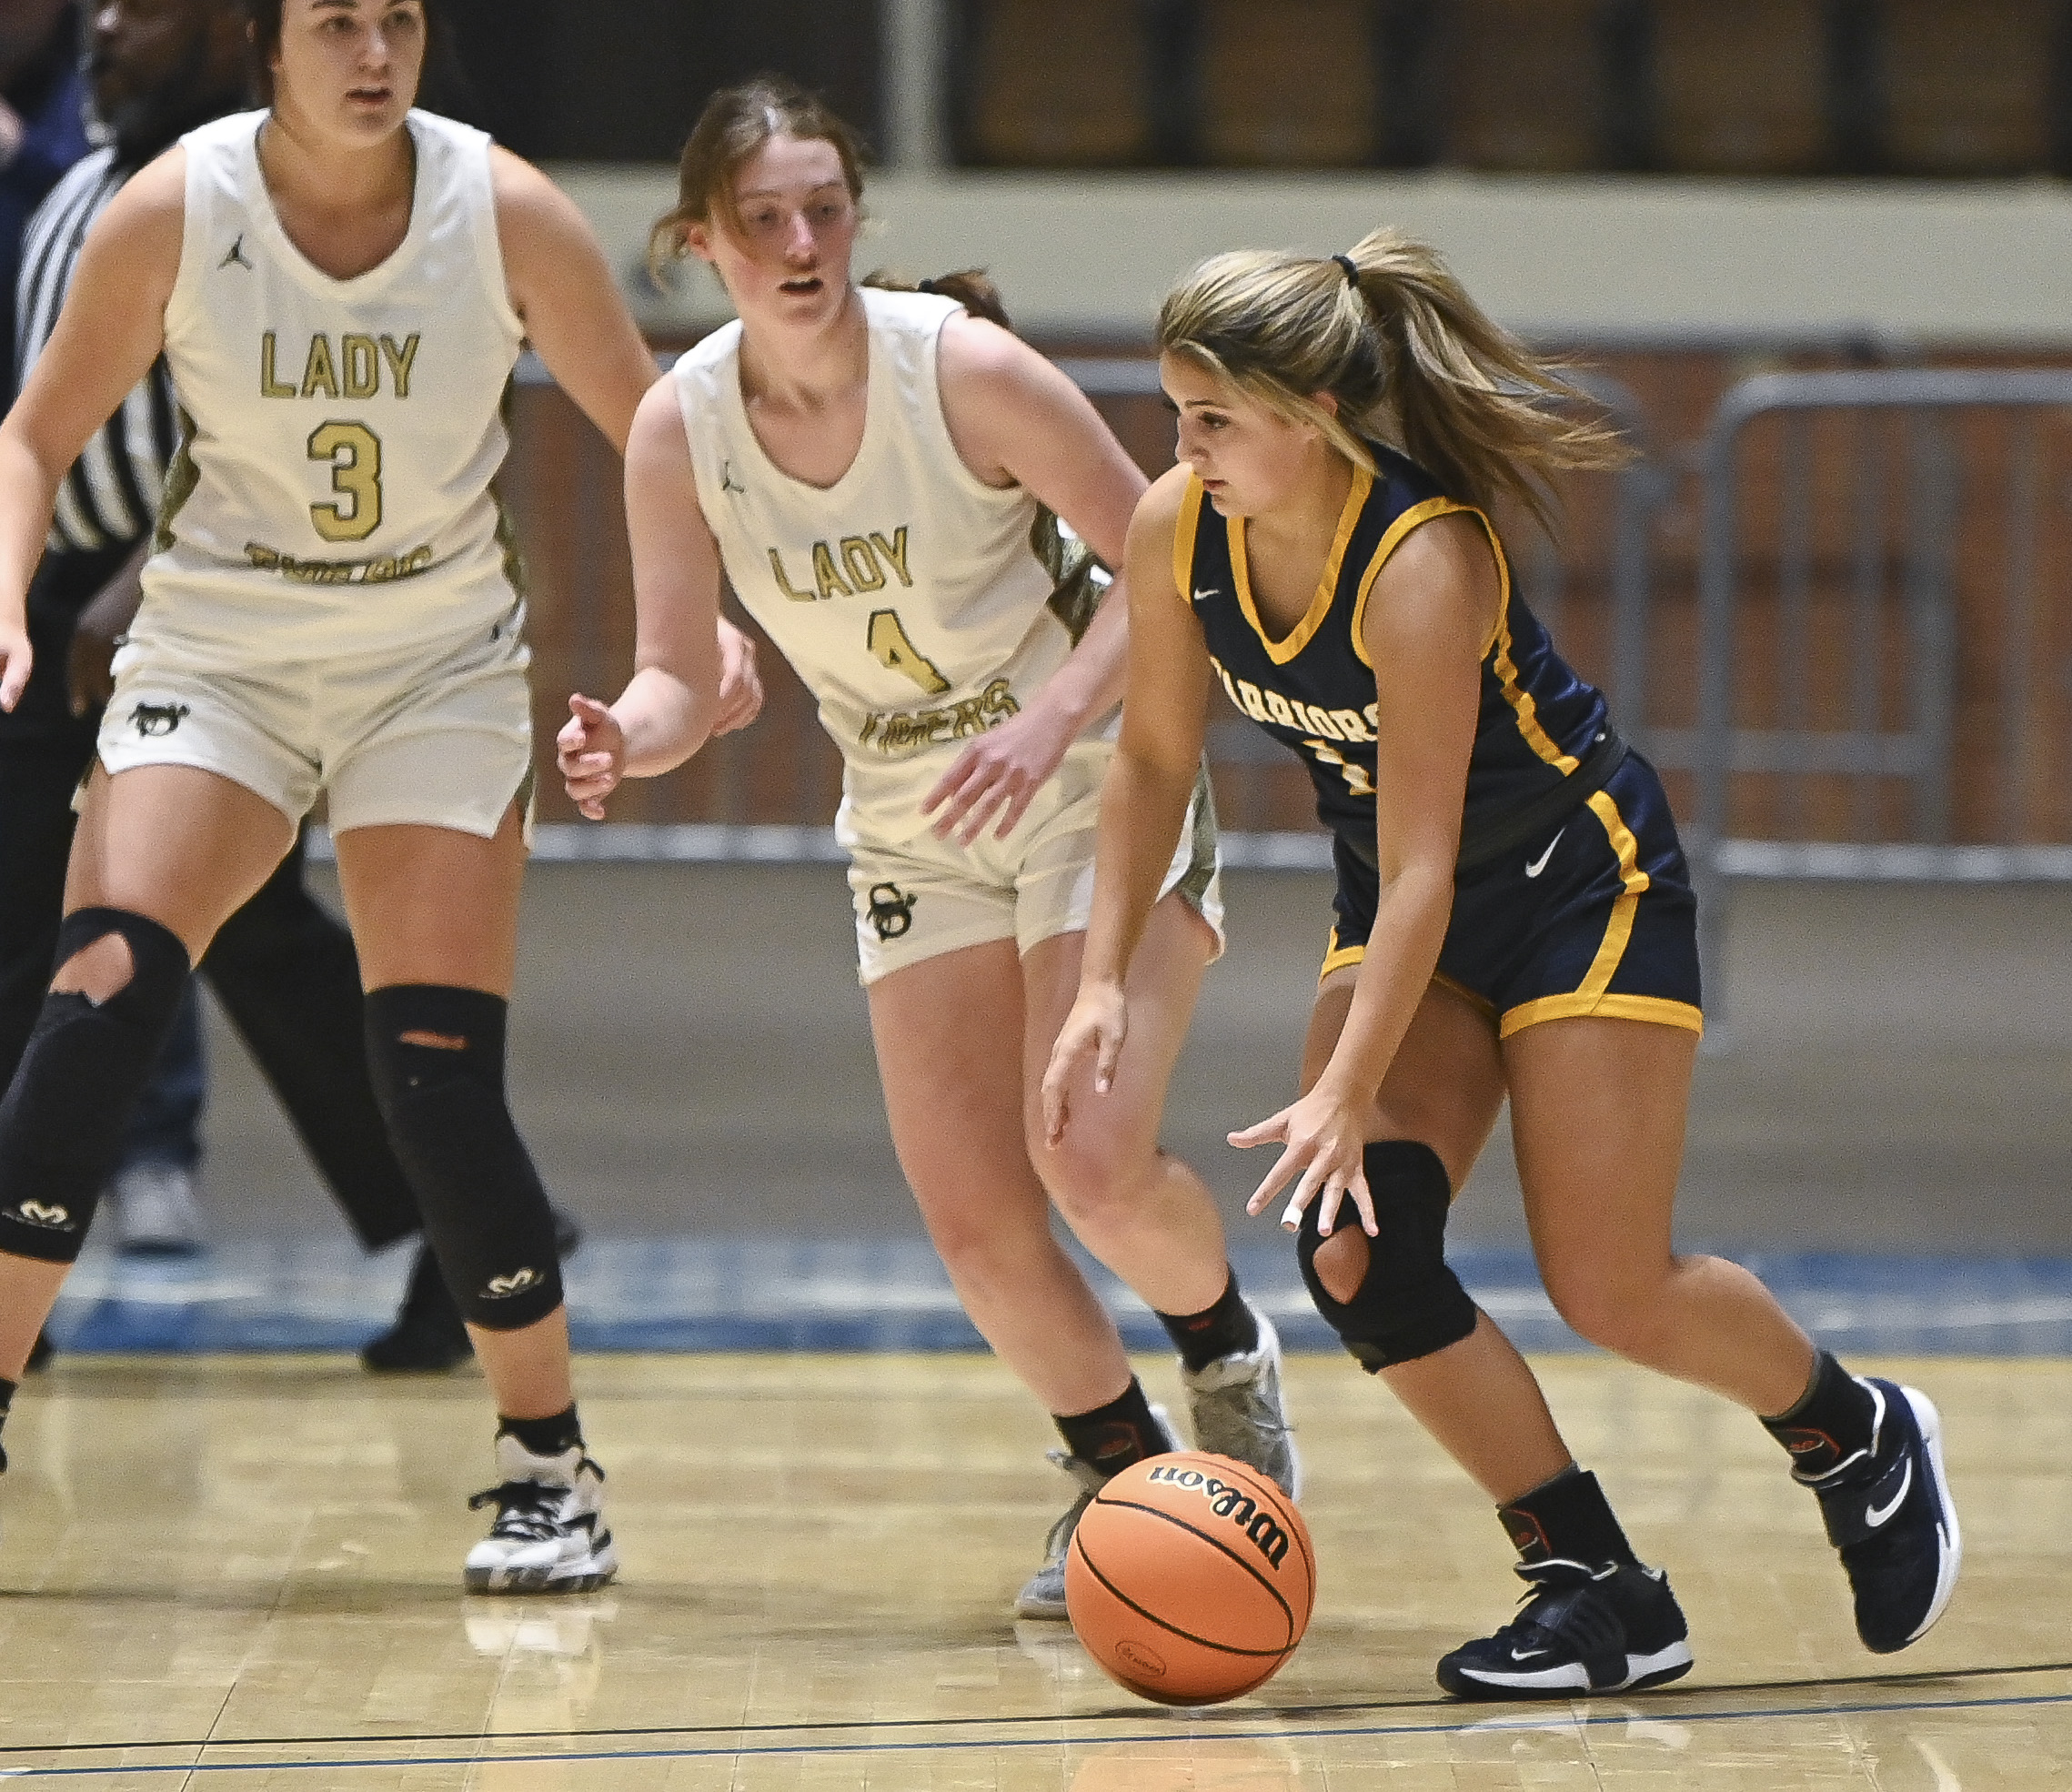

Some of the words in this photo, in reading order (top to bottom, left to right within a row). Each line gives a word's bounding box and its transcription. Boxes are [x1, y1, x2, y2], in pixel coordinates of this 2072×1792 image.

[260, 330, 421, 399] LADY
[307, 419, 382, 542] 3
[768, 523, 913, 602] LADY
[867, 608, 951, 694] 4
[1148, 1465, 1290, 1571] Wilson
